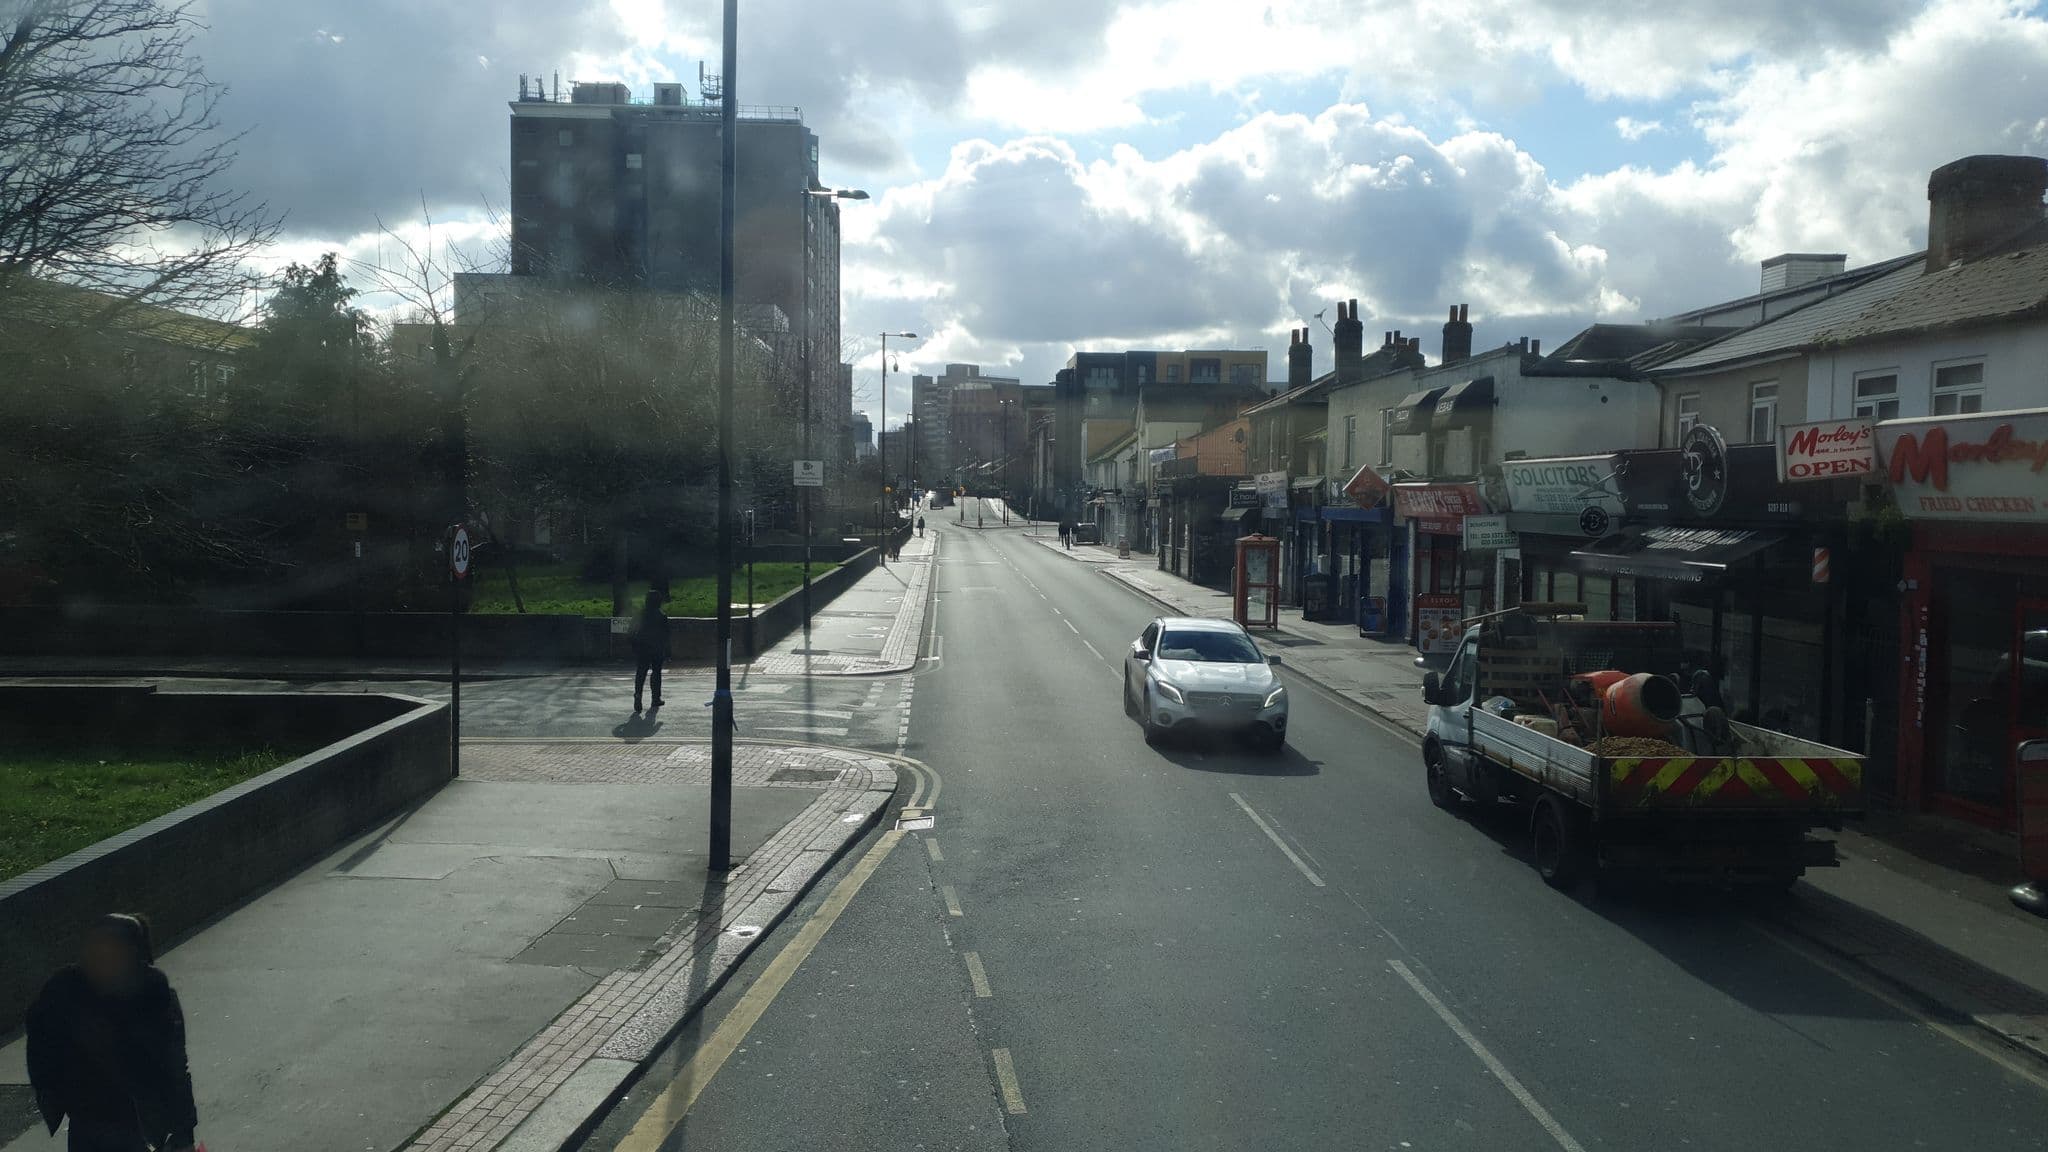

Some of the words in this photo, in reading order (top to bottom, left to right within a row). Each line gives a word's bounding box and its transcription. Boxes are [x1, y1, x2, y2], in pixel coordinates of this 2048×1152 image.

[1788, 424, 1871, 457] Morley's
[1512, 465, 1600, 486] SOLICITORS
[1789, 457, 1872, 477] OPEN
[1919, 496, 1962, 512] FRIED
[1967, 496, 2036, 513] CHICKEN
[455, 540, 467, 562] 20
